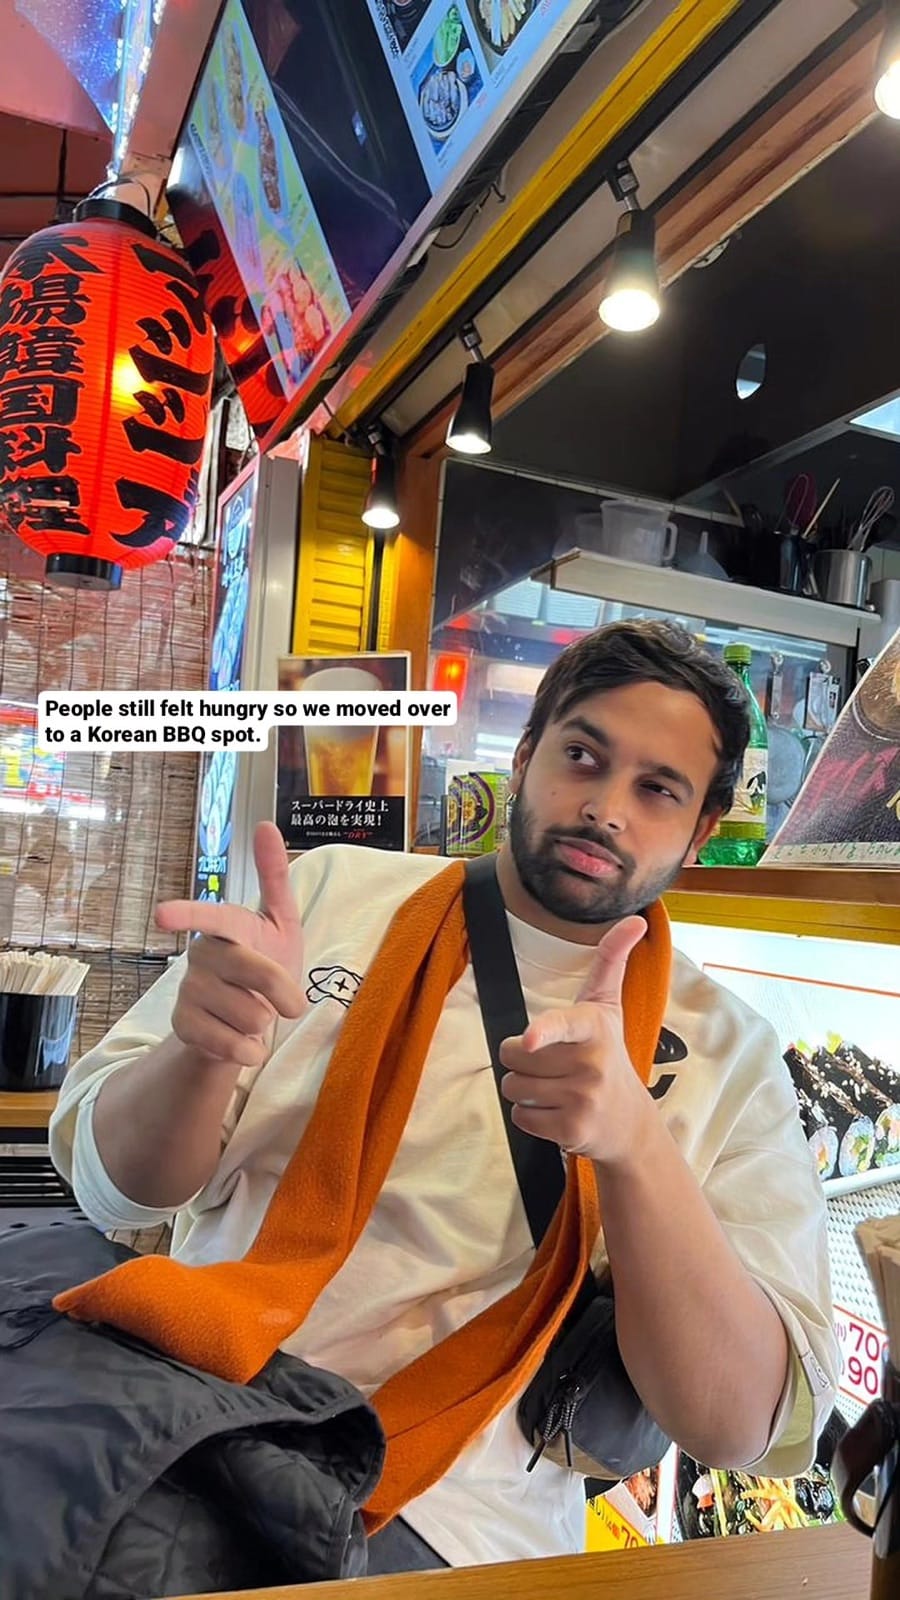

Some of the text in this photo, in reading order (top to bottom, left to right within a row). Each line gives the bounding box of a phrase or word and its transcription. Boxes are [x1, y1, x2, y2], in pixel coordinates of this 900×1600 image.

[291, 799, 389, 812] スーパードライ史上
[849, 1322, 889, 1362] 70
